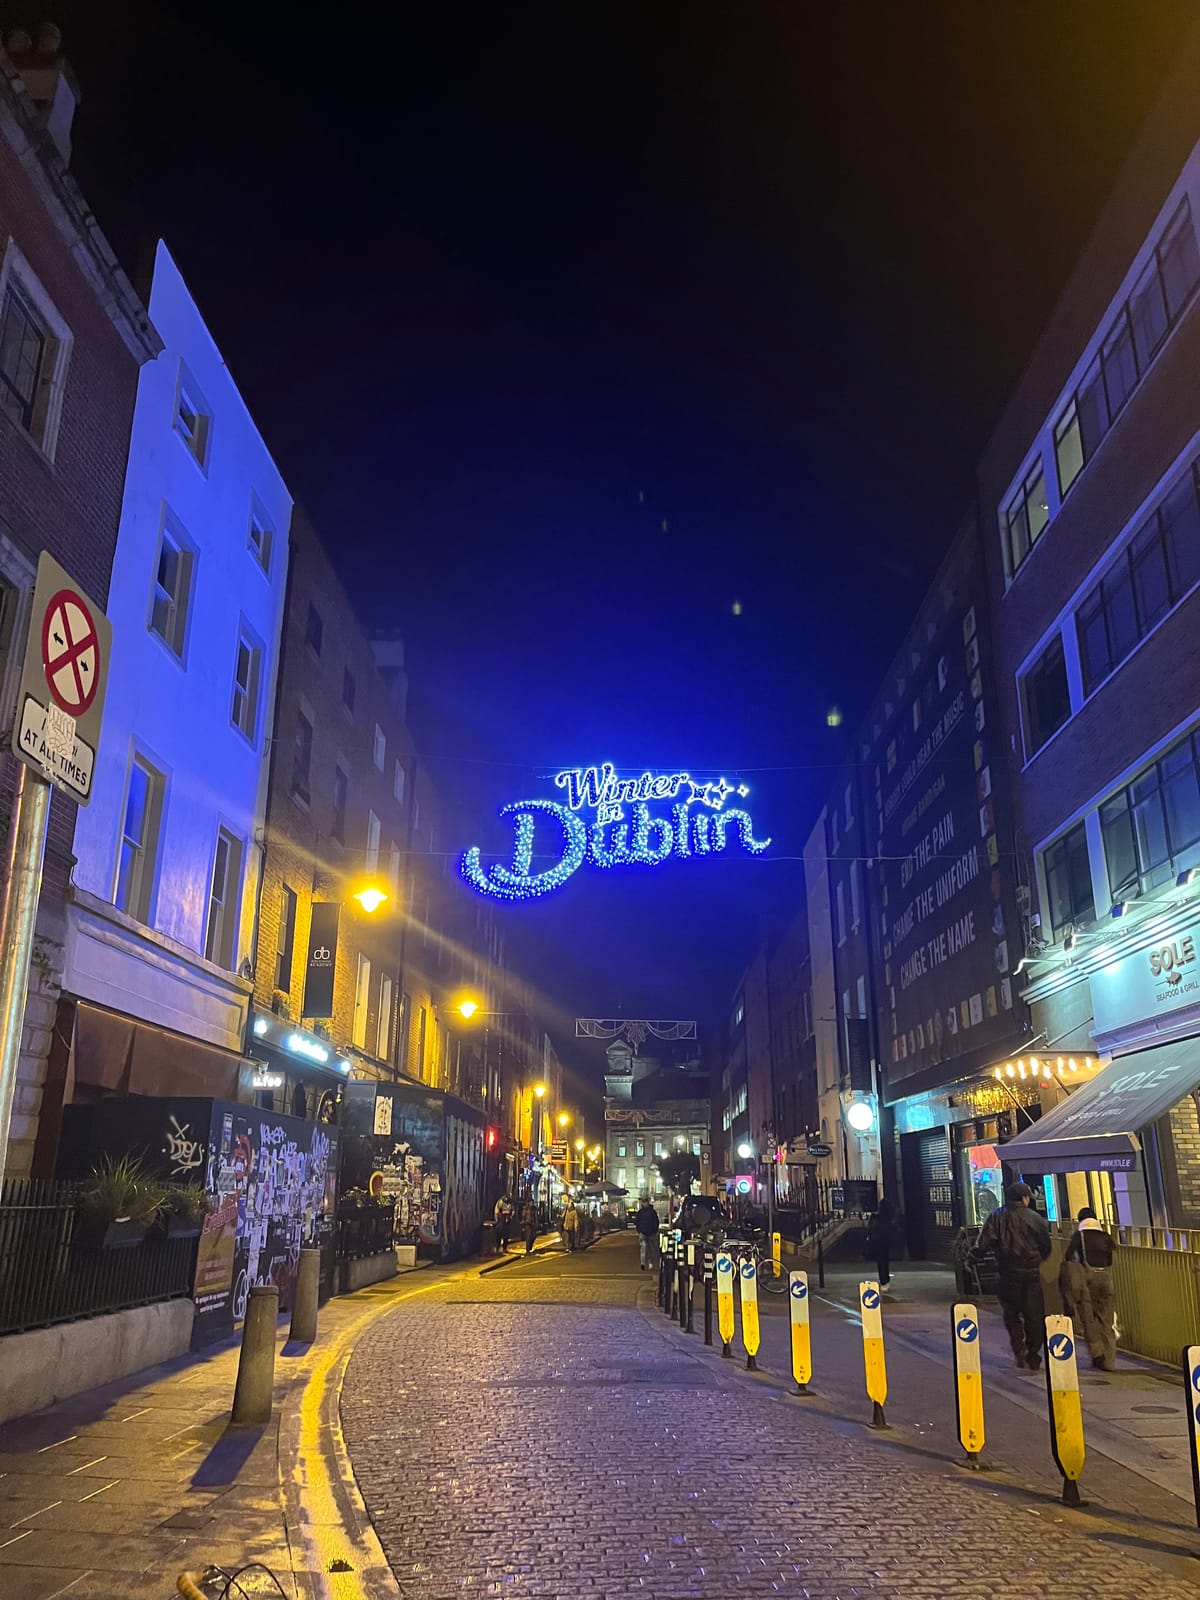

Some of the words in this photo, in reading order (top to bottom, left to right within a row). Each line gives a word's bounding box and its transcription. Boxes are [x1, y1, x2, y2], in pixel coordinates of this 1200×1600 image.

[932, 720, 944, 747] THE
[944, 691, 965, 732] MUSIC
[24, 728, 38, 748] AT
[39, 741, 57, 763] ALL
[60, 755, 87, 786] TIMES
[555, 763, 688, 811] Winter
[597, 801, 624, 825] in
[460, 799, 772, 901] Dublin
[901, 854, 913, 888] END
[914, 833, 931, 873] THE
[932, 810, 955, 855] PAIN
[915, 885, 935, 923] THE
[935, 845, 979, 908] UNIFORM
[899, 947, 928, 990] CHANGE
[928, 934, 948, 969] THE
[947, 910, 976, 956] NAME
[1149, 935, 1196, 977] SOLE
[1156, 984, 1179, 1002] SEAFOOD
[1185, 980, 1199, 994] GRILL
[1098, 1065, 1182, 1097] SOLE
